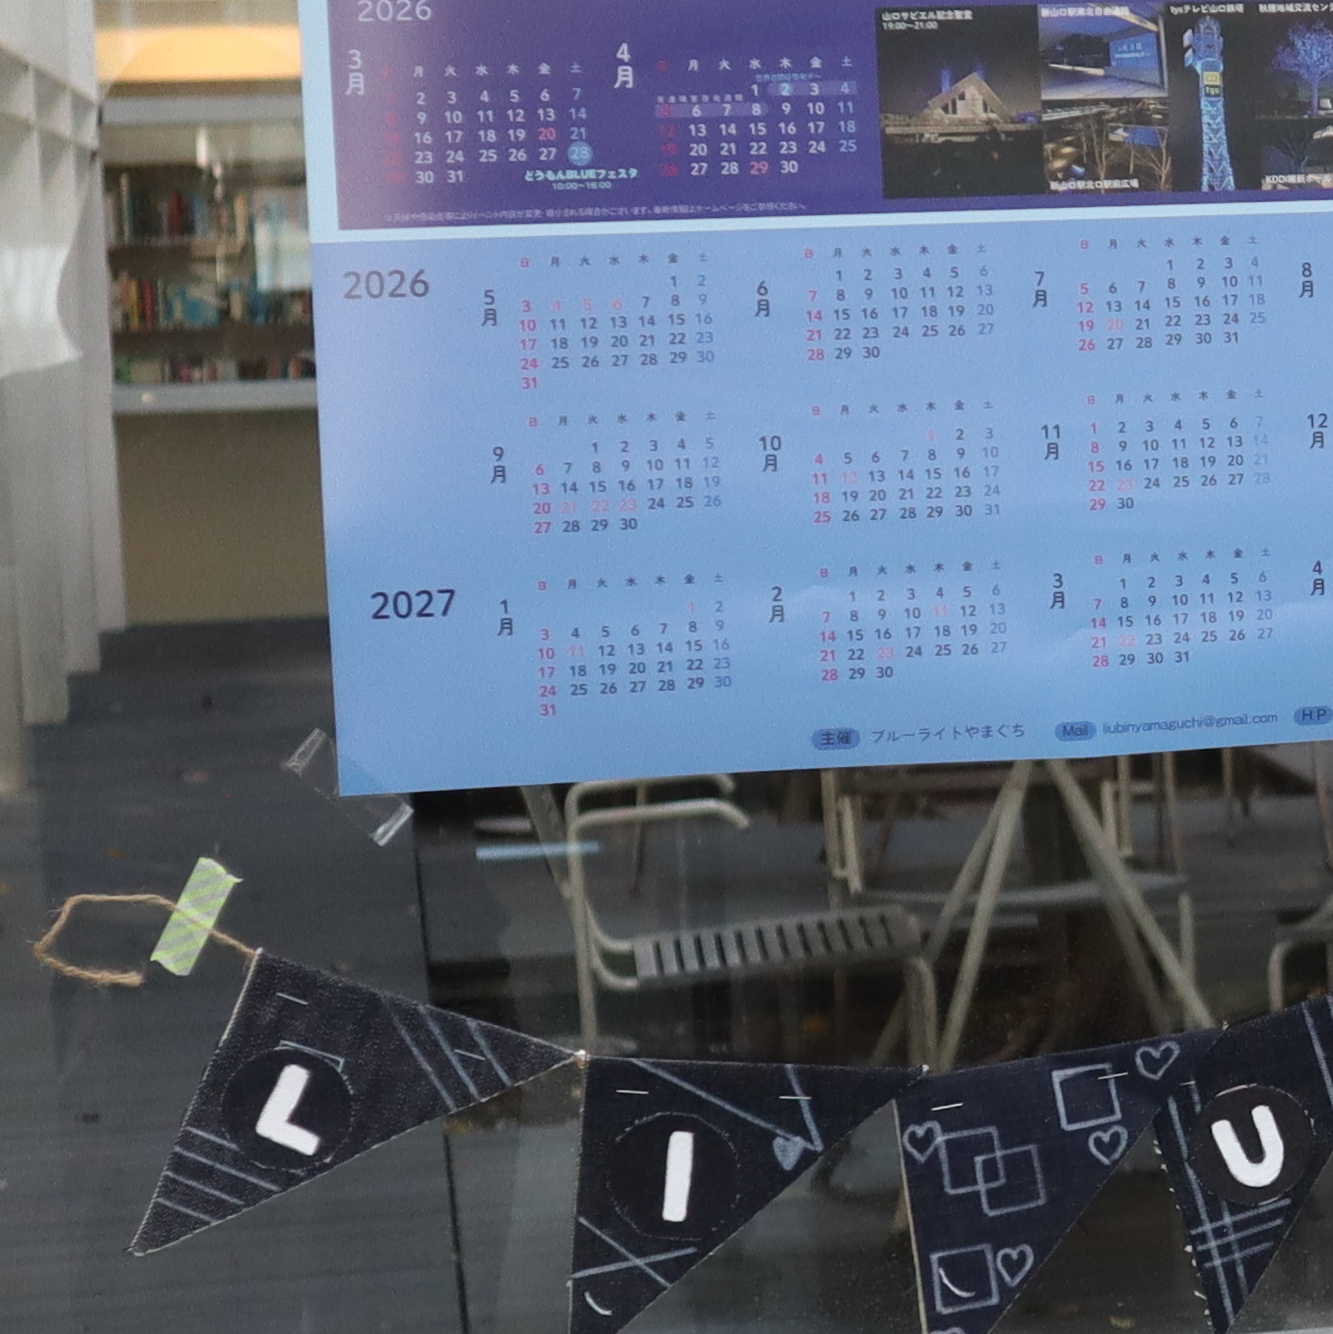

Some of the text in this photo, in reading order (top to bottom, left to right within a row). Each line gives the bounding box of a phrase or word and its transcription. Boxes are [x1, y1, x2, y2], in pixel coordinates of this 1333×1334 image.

[344, 48, 367, 98] 3月
[614, 42, 635, 90] 4月
[343, 269, 431, 300] 2026
[481, 289, 499, 328] 5月
[1049, 572, 1066, 611] 3月
[1310, 559, 1327, 598] 4月
[370, 588, 456, 621] 2027
[498, 599, 514, 638] 1月
[871, 723, 1026, 744] ブルーライトやまぐち
[1061, 722, 1089, 739] Mail
[256, 1063, 322, 1157] L
[1211, 1104, 1285, 1188] U
